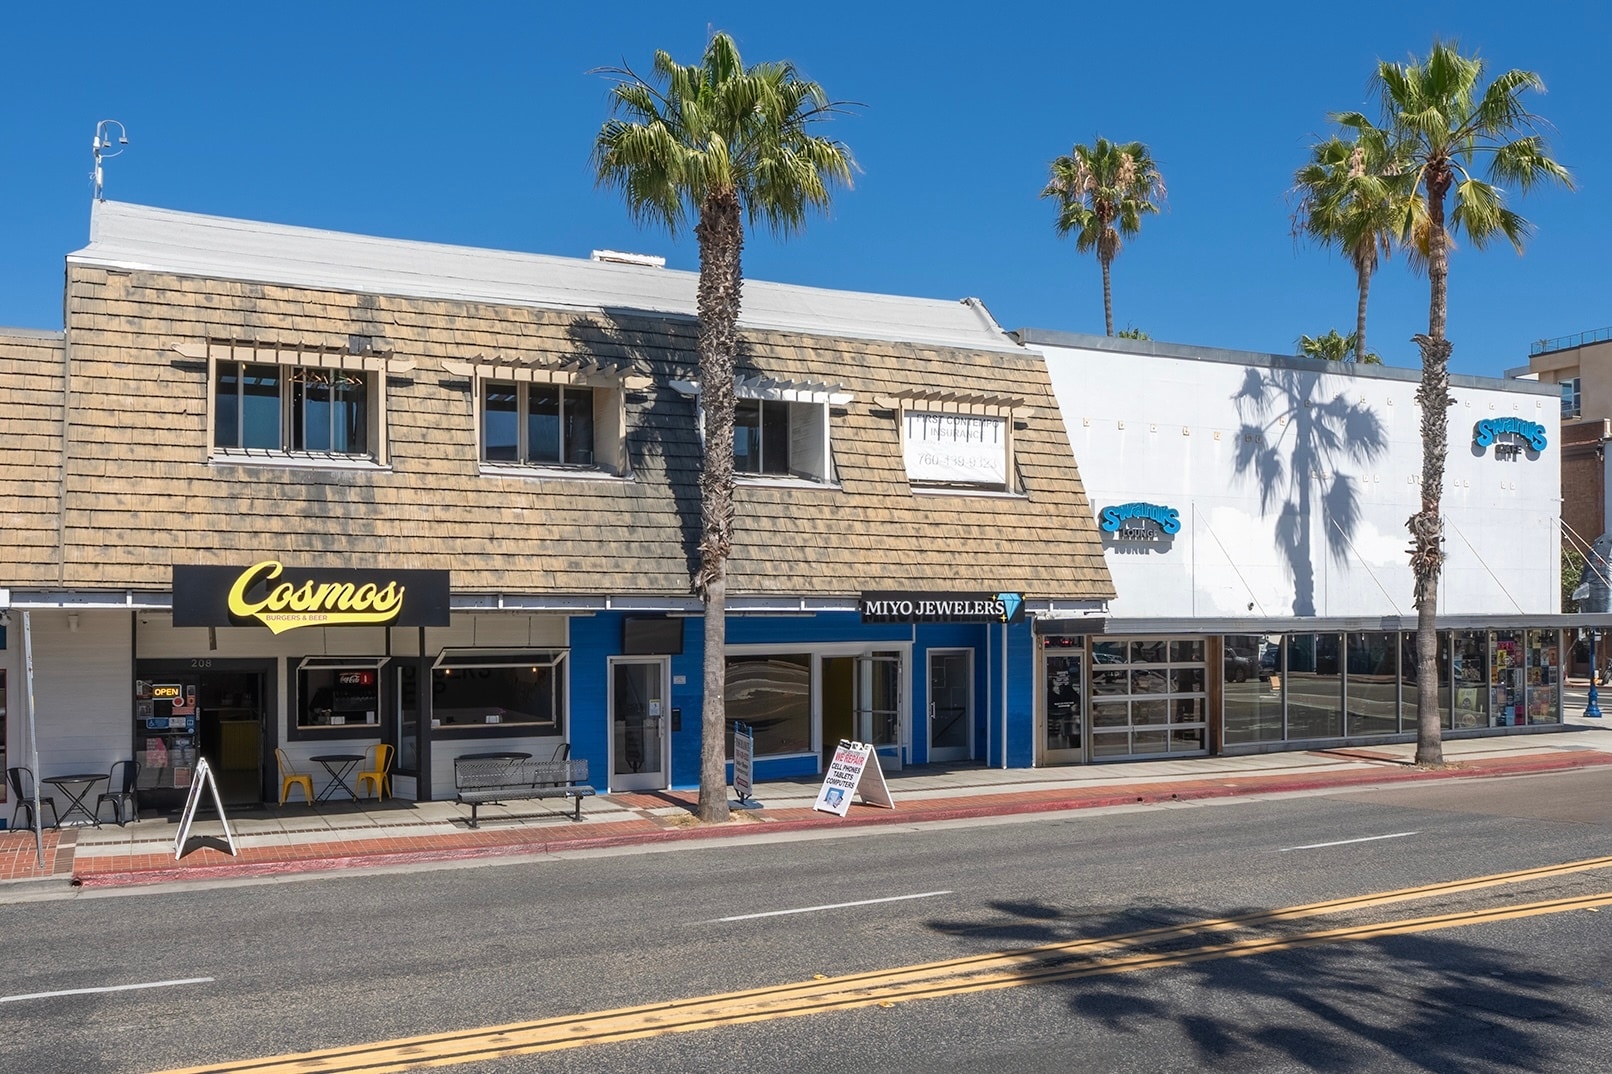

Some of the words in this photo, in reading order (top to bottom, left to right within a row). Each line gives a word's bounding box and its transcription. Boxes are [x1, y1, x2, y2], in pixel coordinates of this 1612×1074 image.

[930, 427, 981, 439] INSURANC
[1122, 529, 1158, 538] LOUNGE
[228, 560, 404, 617] Cosmos
[865, 600, 913, 615] MIYO
[915, 600, 1005, 615] JEWELERS
[154, 688, 179, 696] OPEN
[844, 753, 864, 766] REPAIR
[831, 762, 843, 771] CELL
[843, 764, 861, 775] PHONES
[834, 770, 854, 781] TABLETS
[826, 777, 855, 789] COMPUTERS
